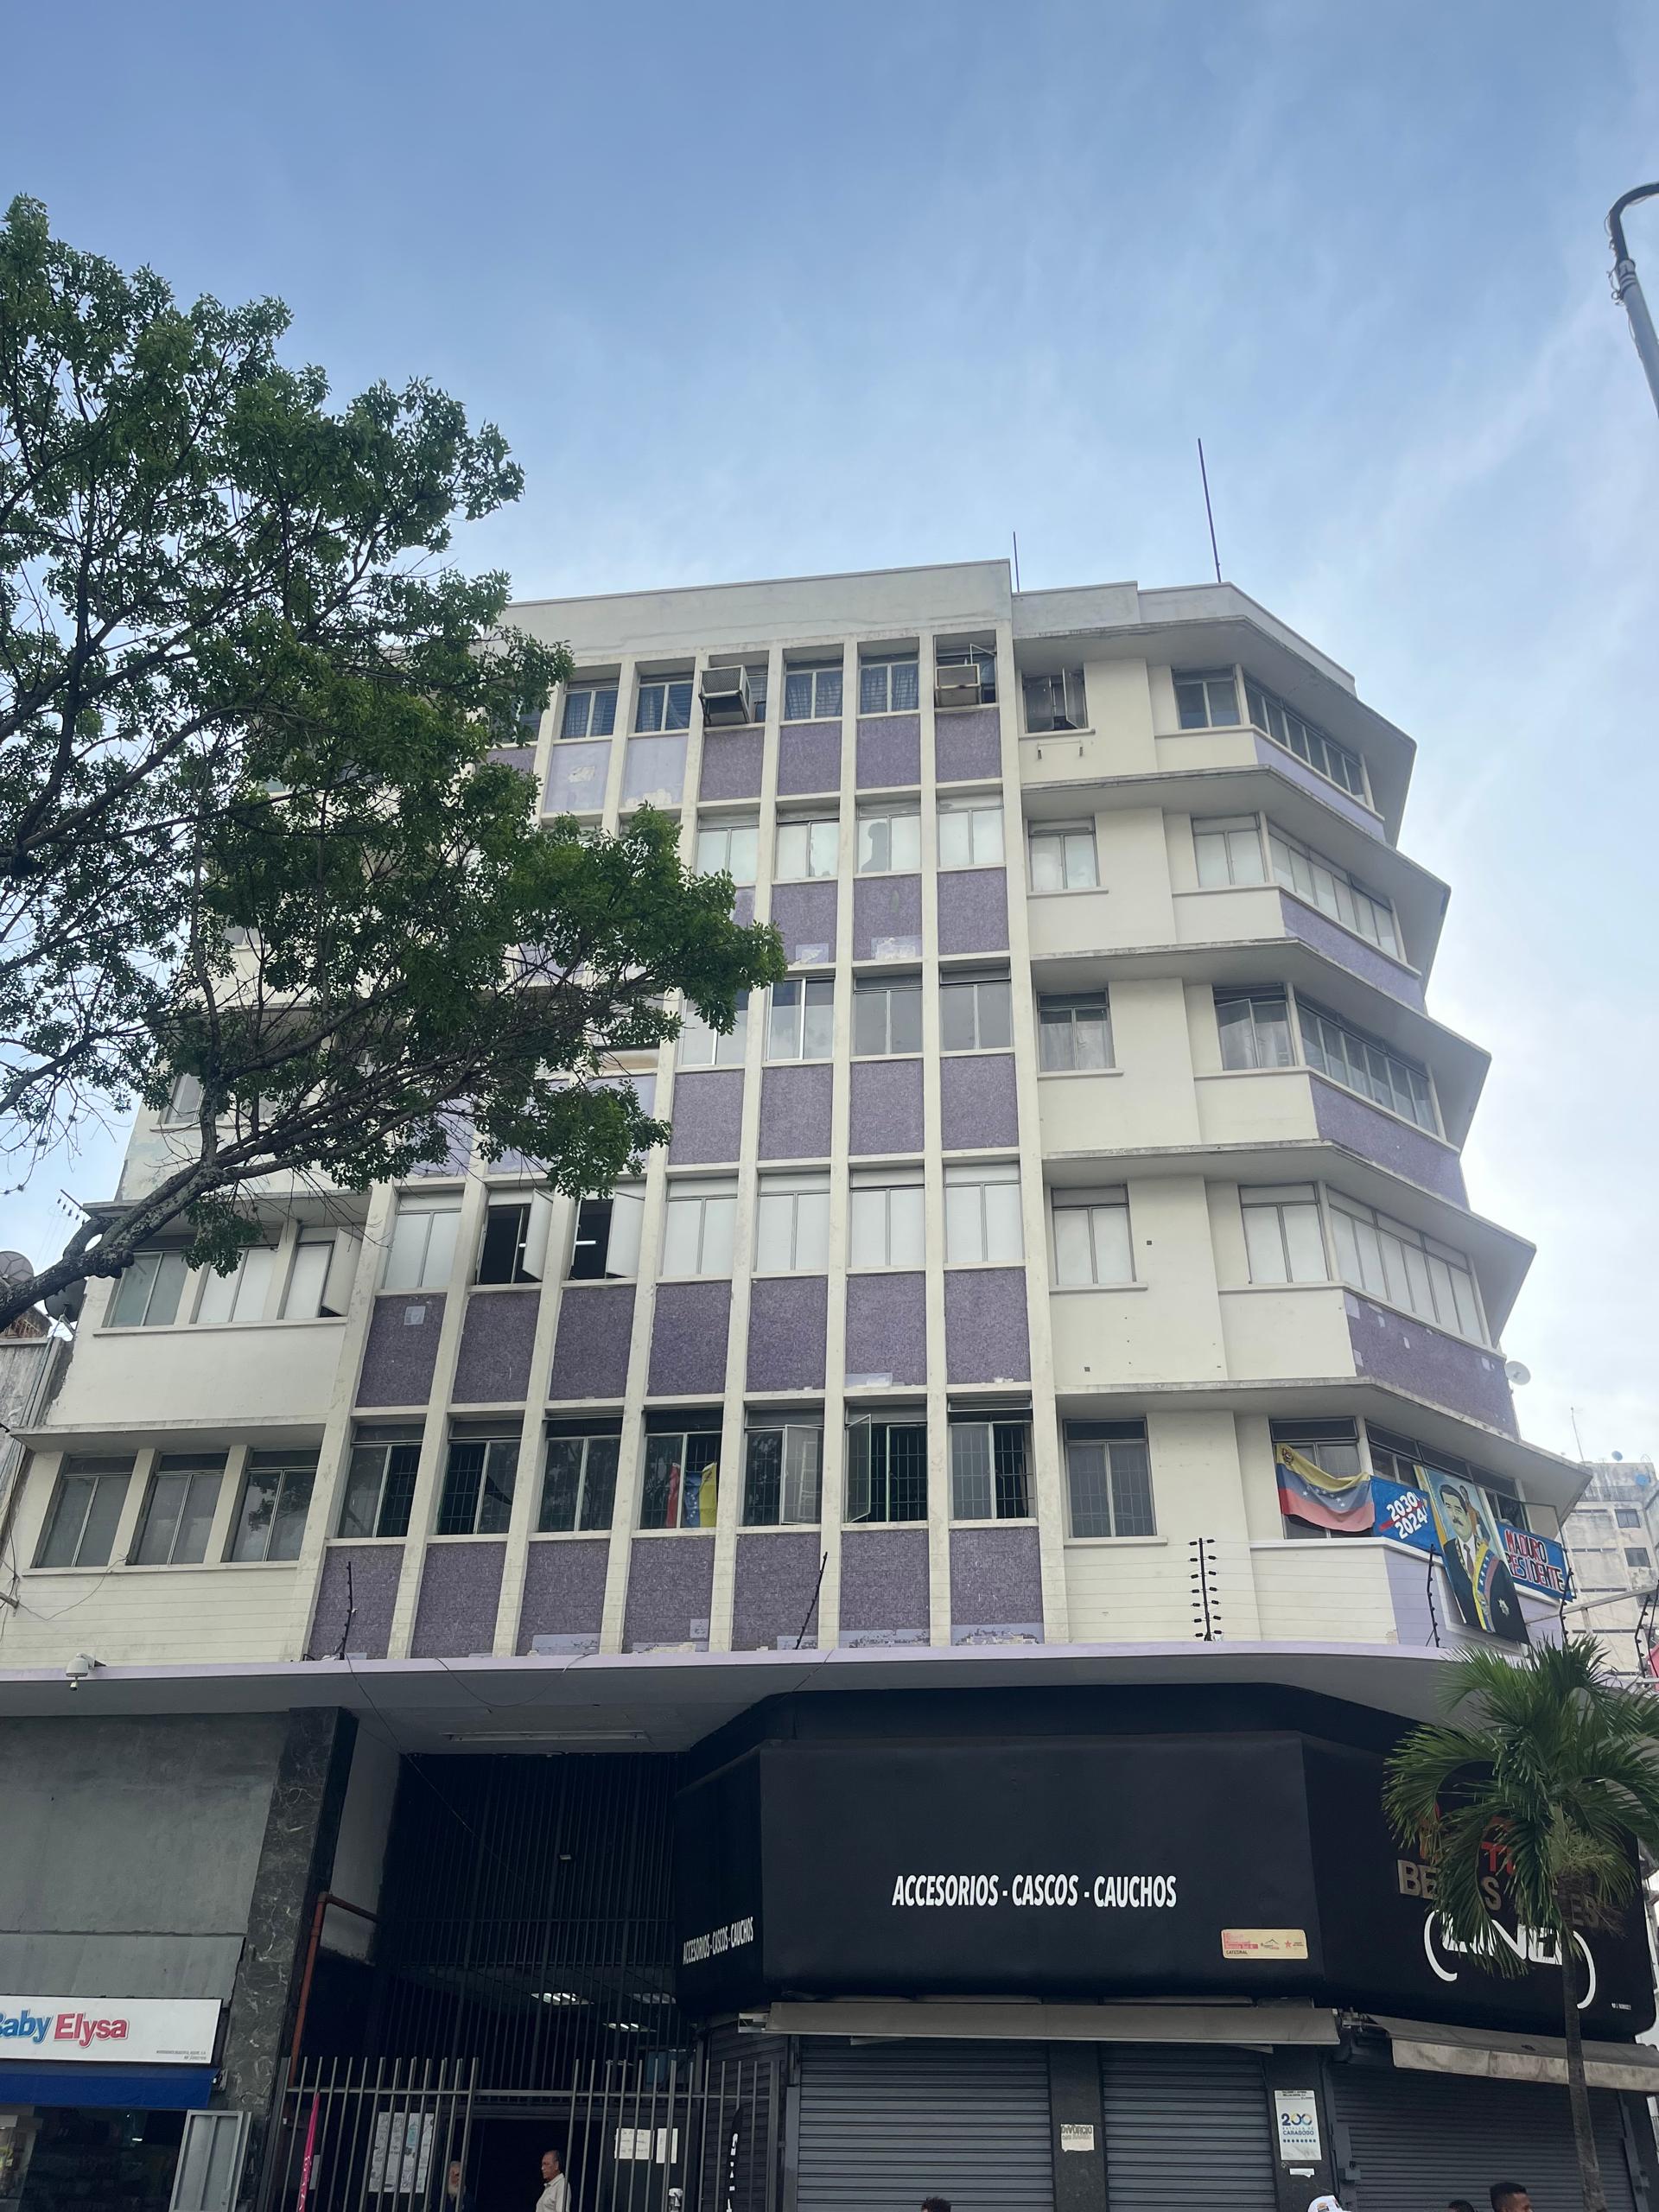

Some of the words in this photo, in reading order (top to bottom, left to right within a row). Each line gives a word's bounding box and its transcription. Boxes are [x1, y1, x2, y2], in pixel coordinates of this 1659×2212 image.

[1386, 1491, 1419, 1522] 2030
[1504, 1529, 1548, 1564] MADURO
[1503, 1551, 1566, 1594] RESIDENTE
[892, 1874, 999, 1907] ACCESORIOS
[1013, 1874, 1079, 1906] CASCOS
[1094, 1875, 1177, 1908] CAUCHOS
[683, 1934, 710, 1965] ACCESORIOS
[712, 1925, 728, 1955] CASCOS
[730, 1916, 753, 1948] CAUCHOS
[54, 2012, 129, 2048] Elysa
[1281, 2113, 1313, 2126] 200
